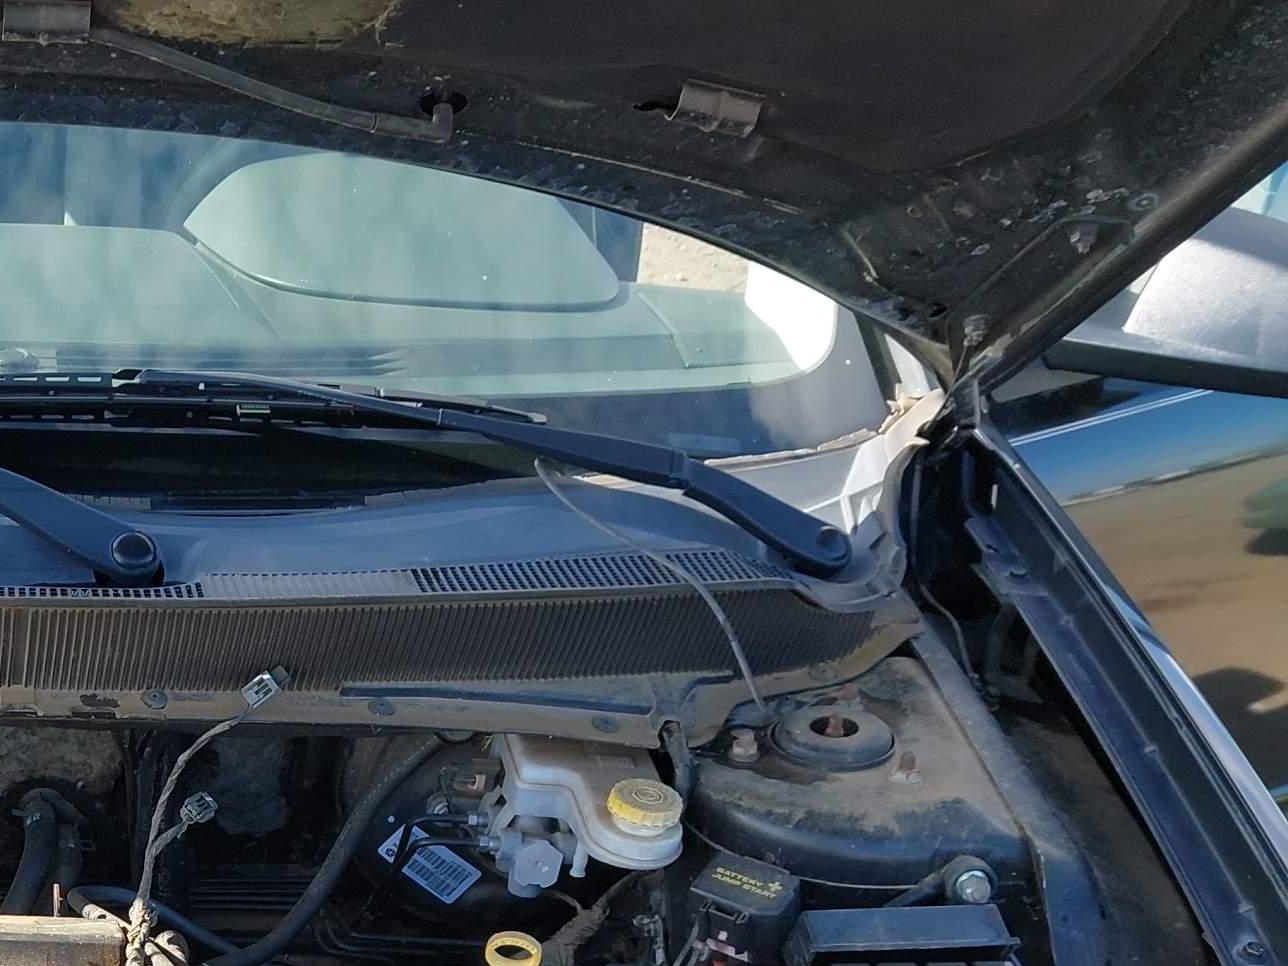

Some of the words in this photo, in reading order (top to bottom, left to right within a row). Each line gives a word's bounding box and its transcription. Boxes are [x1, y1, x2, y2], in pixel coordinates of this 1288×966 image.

[712, 873, 742, 886] JUMP
[742, 883, 777, 898] START
[716, 866, 763, 887] BATTERY
